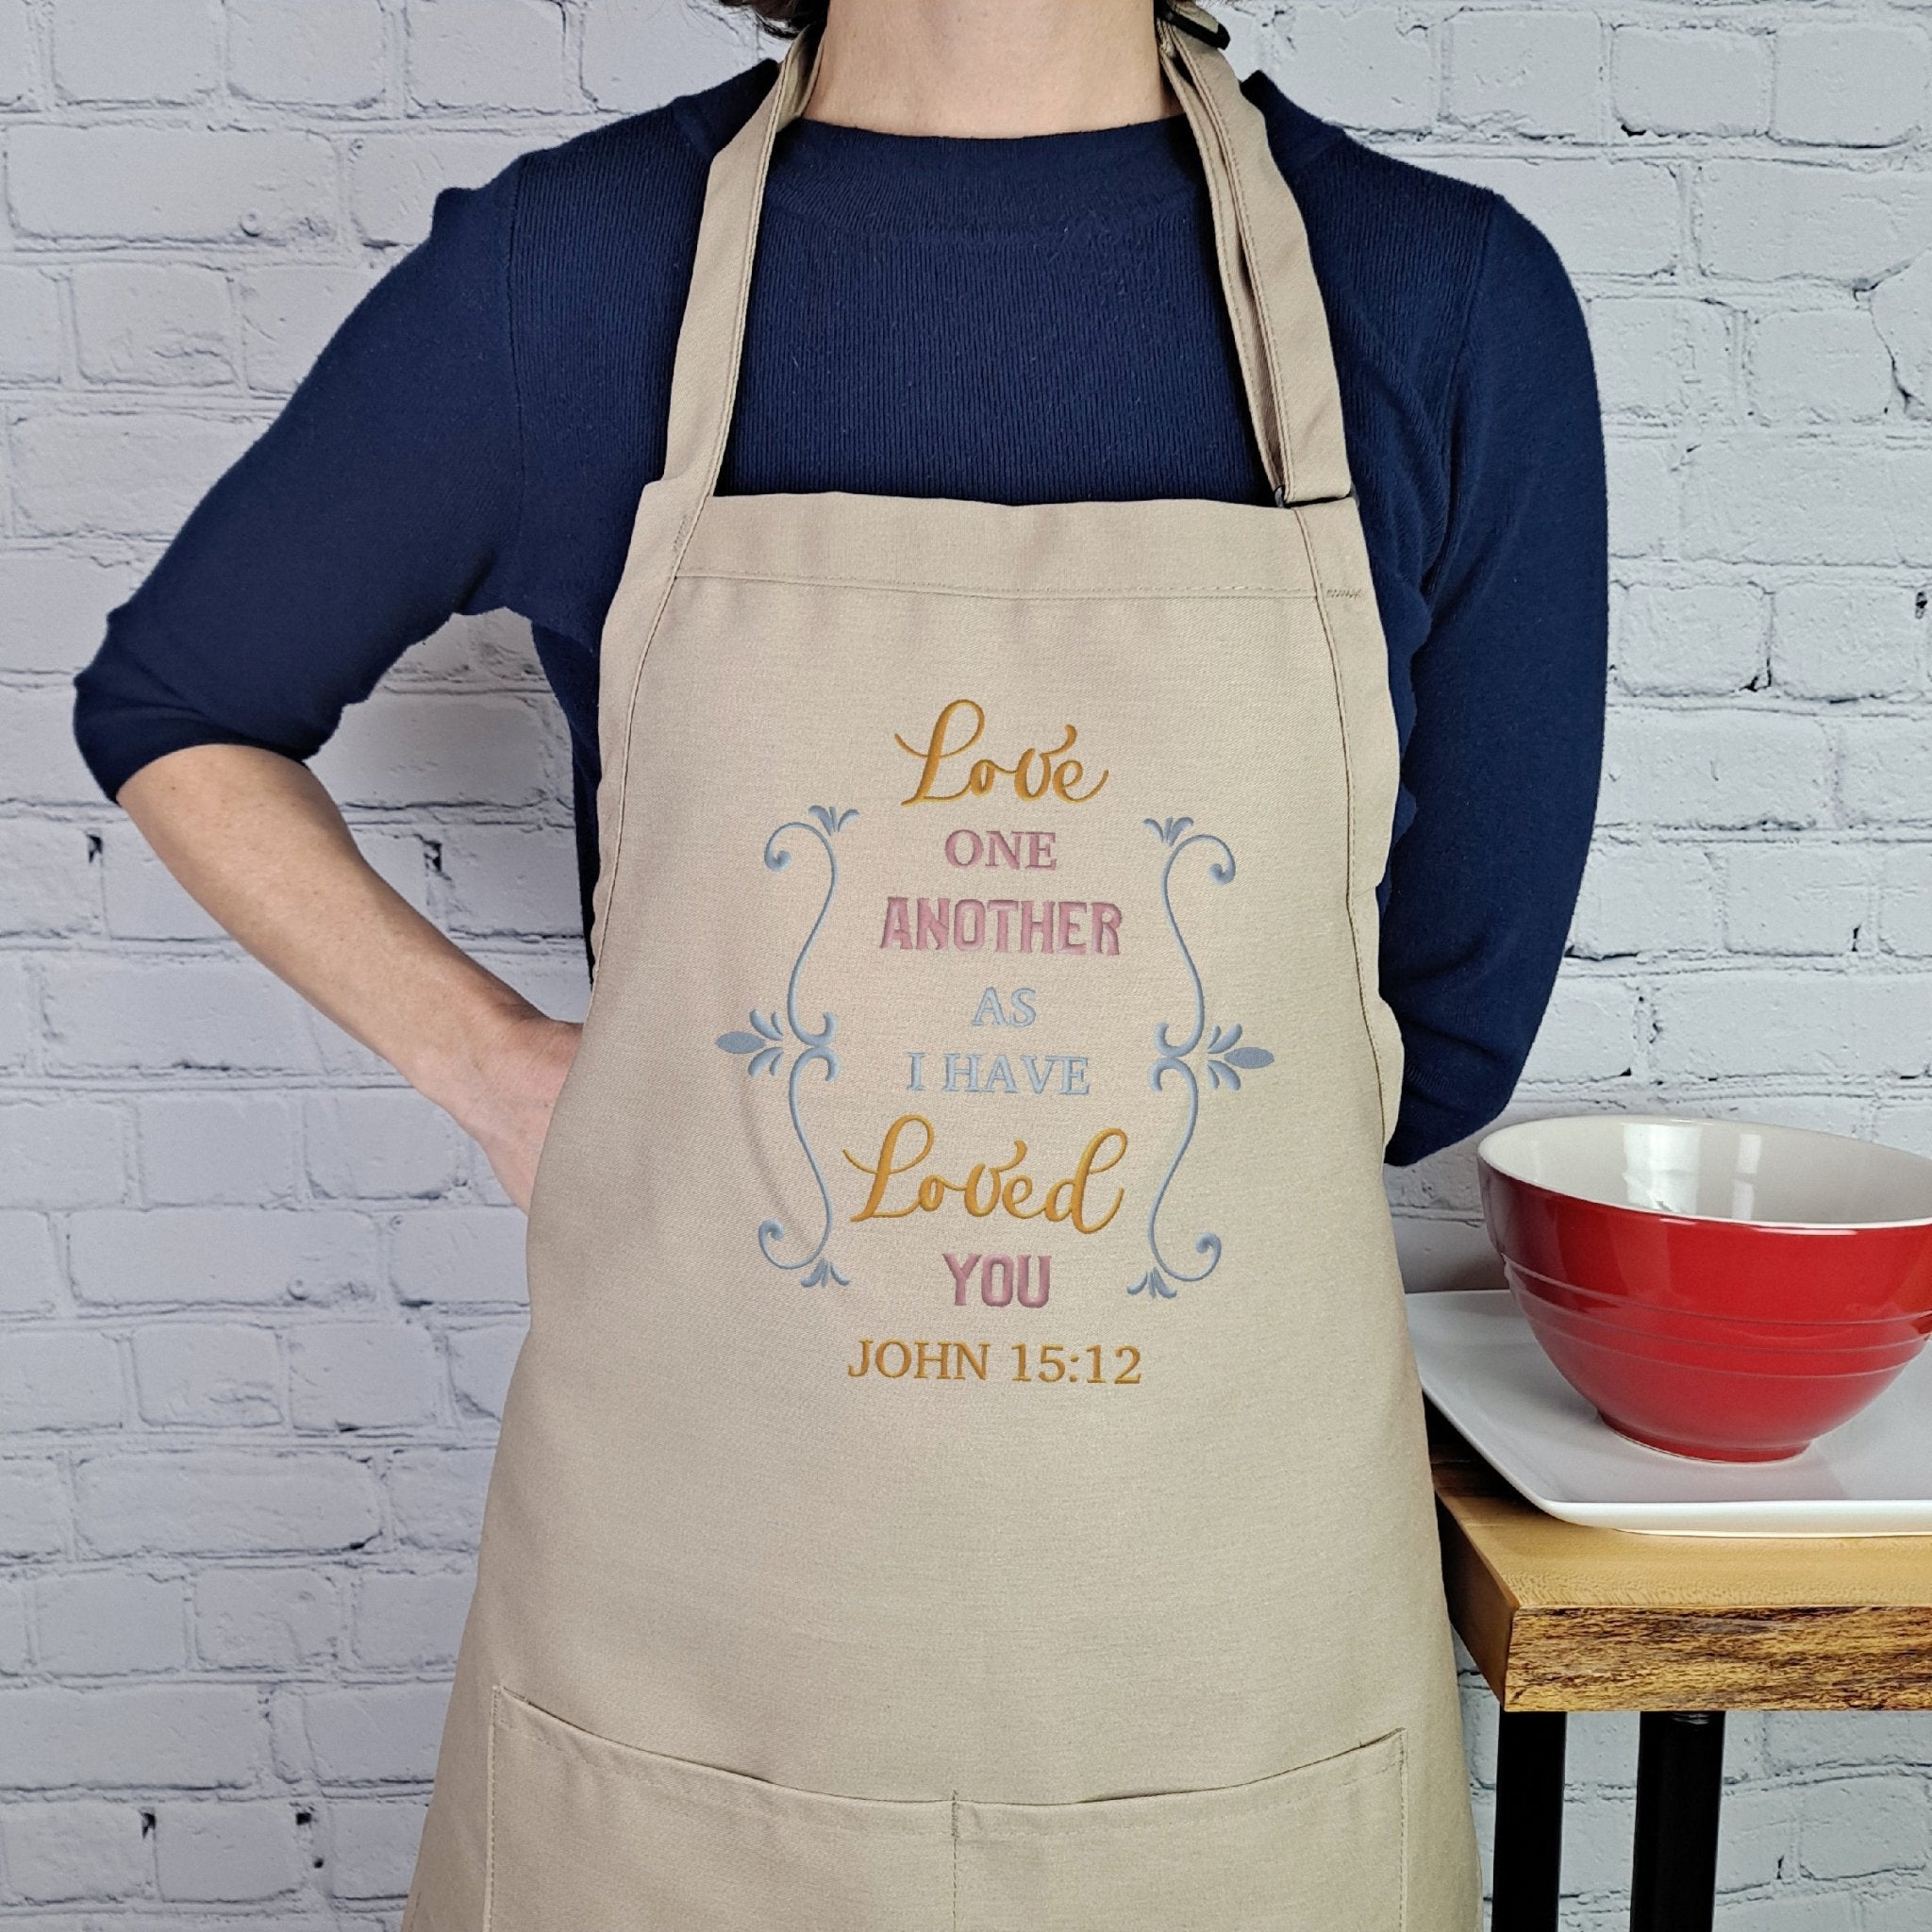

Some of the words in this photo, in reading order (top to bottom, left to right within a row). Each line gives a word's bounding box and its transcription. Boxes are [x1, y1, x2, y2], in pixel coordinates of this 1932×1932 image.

[893, 698, 1109, 807] Love
[944, 828, 1058, 871] ONE
[879, 896, 1123, 957] ANOTHER
[971, 987, 1038, 1027] AS
[907, 1052, 925, 1091] I
[944, 1053, 1091, 1096] HAVE
[842, 1114, 1128, 1235] Loved
[941, 1253, 1052, 1308] YOU
[848, 1339, 989, 1382] JOHN
[1011, 1343, 1142, 1385] 15:12
